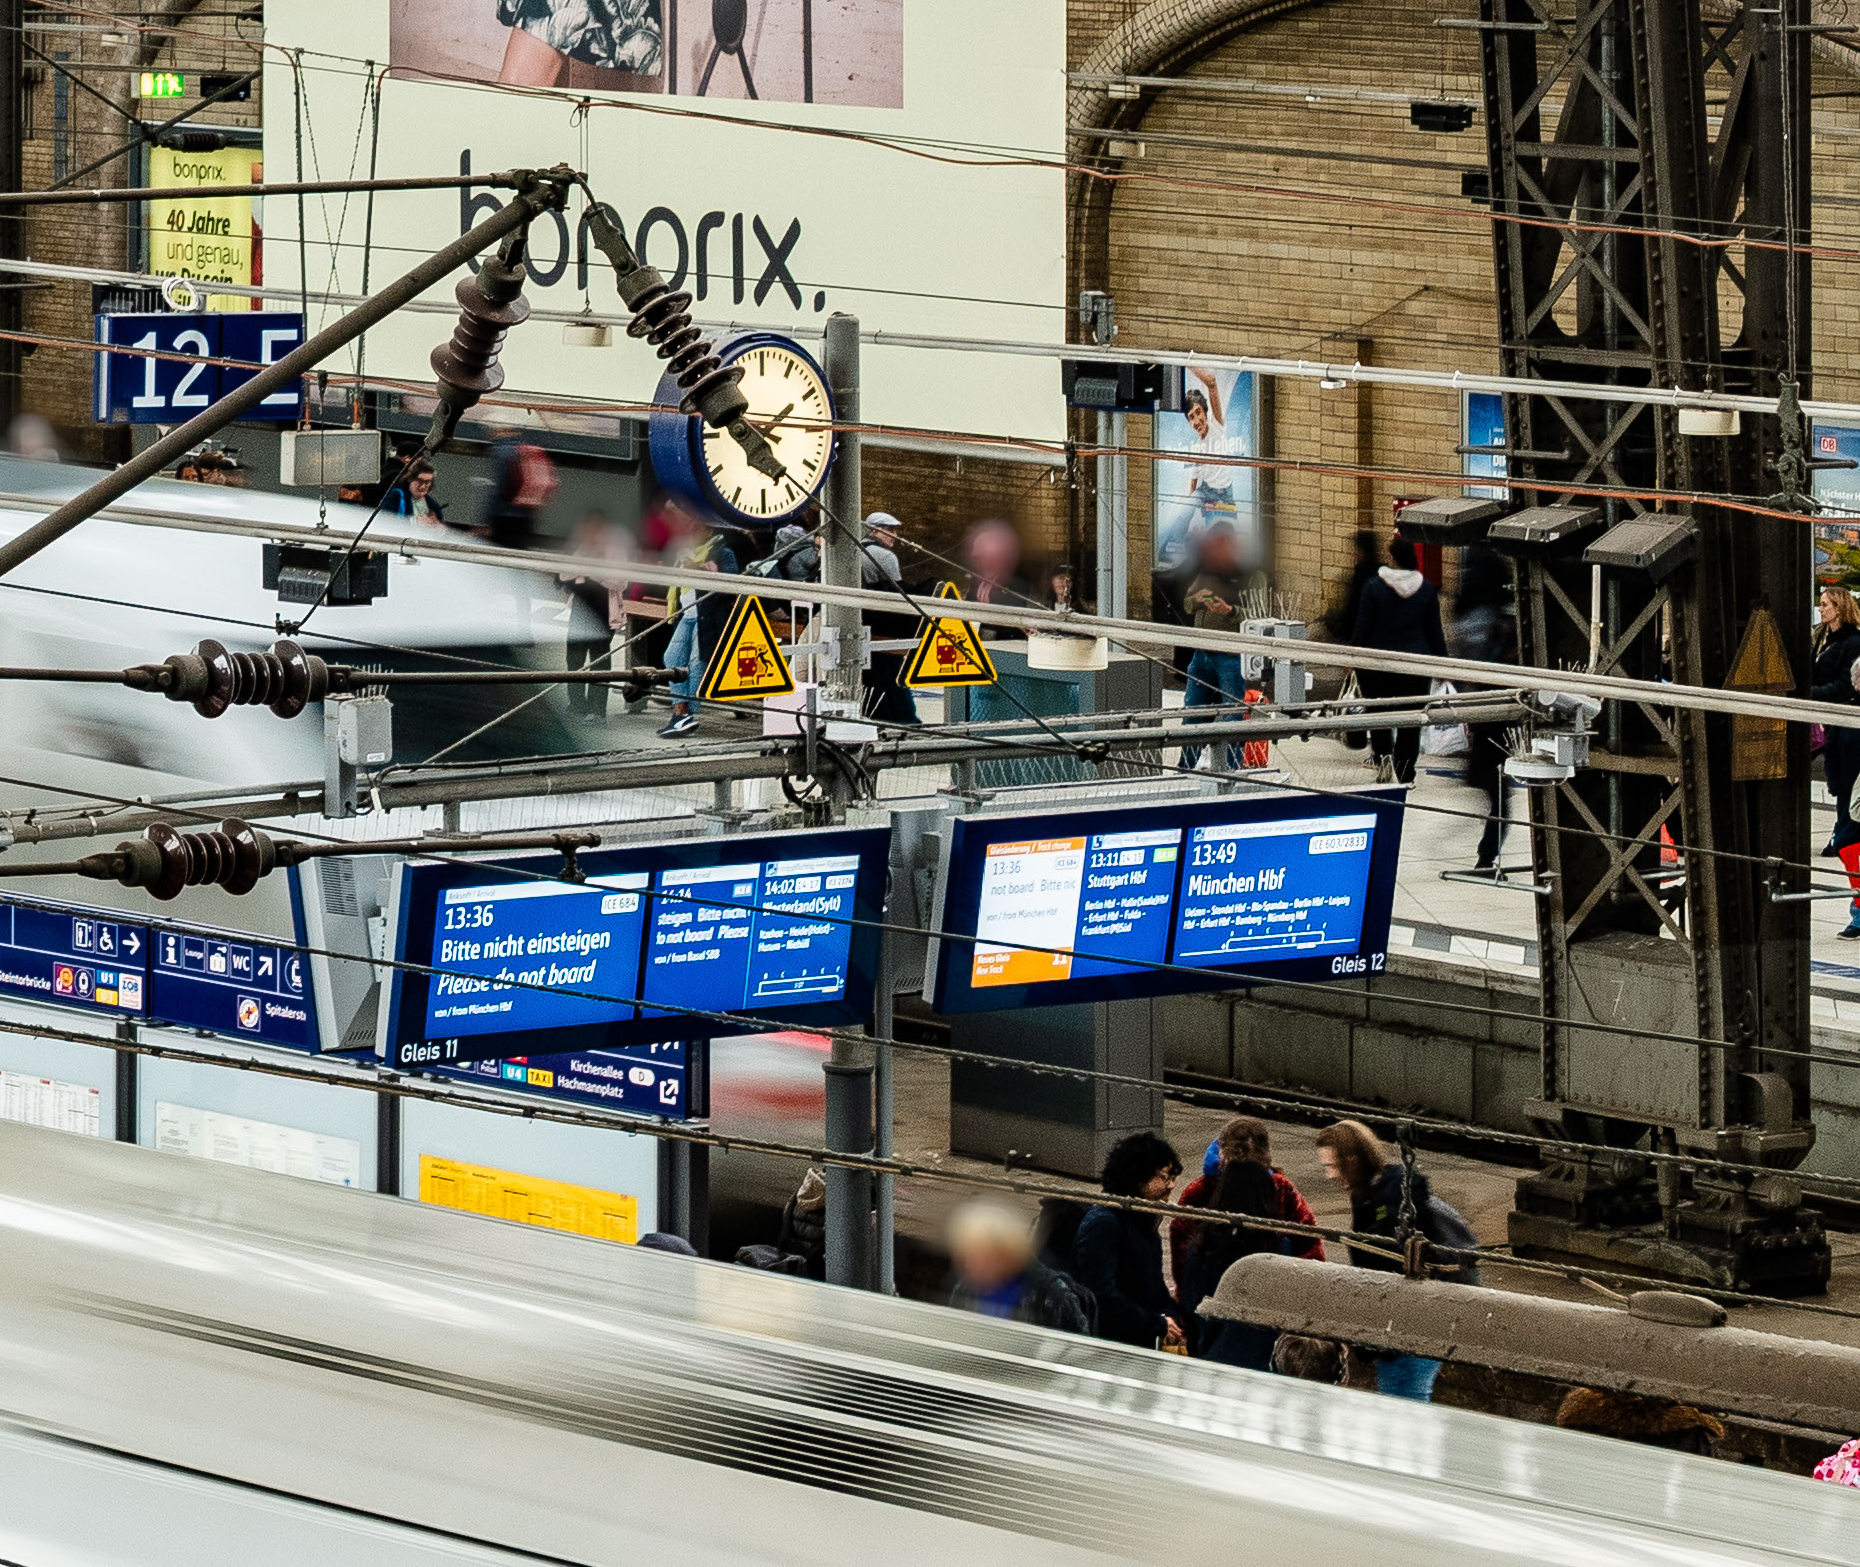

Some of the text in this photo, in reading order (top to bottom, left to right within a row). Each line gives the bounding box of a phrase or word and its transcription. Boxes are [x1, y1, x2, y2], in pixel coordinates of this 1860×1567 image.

[173, 156, 227, 186] bonprix.
[167, 209, 231, 235] 40 Jahre
[167, 237, 244, 270] und genau,
[130, 328, 210, 409] 12
[1822, 438, 1835, 451] DB
[1090, 852, 1119, 868] 13:11
[1191, 835, 1366, 866] 13:49 ICE 603/2833
[992, 860, 1021, 876] 13:36
[764, 878, 795, 896] 14:02
[991, 879, 1062, 896] not board Bitte
[1088, 869, 1148, 890] Stuttgart Hbf
[1188, 867, 1287, 897] München Hbf
[443, 897, 637, 931] 13:36 ICE 684
[697, 907, 722, 923] Bitte
[665, 925, 750, 944] not board Please
[440, 929, 611, 963] Bitte nicht einsteigen
[232, 954, 251, 972] WC
[687, 951, 705, 962] Basel
[1332, 953, 1386, 975] Gleis 12
[100, 973, 114, 984] U1
[492, 966, 515, 990] do
[516, 965, 546, 988] not
[548, 958, 598, 985] board
[122, 980, 140, 993] ZOB
[468, 1002, 499, 1015] München
[400, 1038, 459, 1063] Gleis 11
[507, 1067, 523, 1081] U4
[529, 1071, 552, 1086] TAXI
[570, 1059, 624, 1080] Kirchenallee
[557, 1074, 624, 1099] Hachmannplatz
